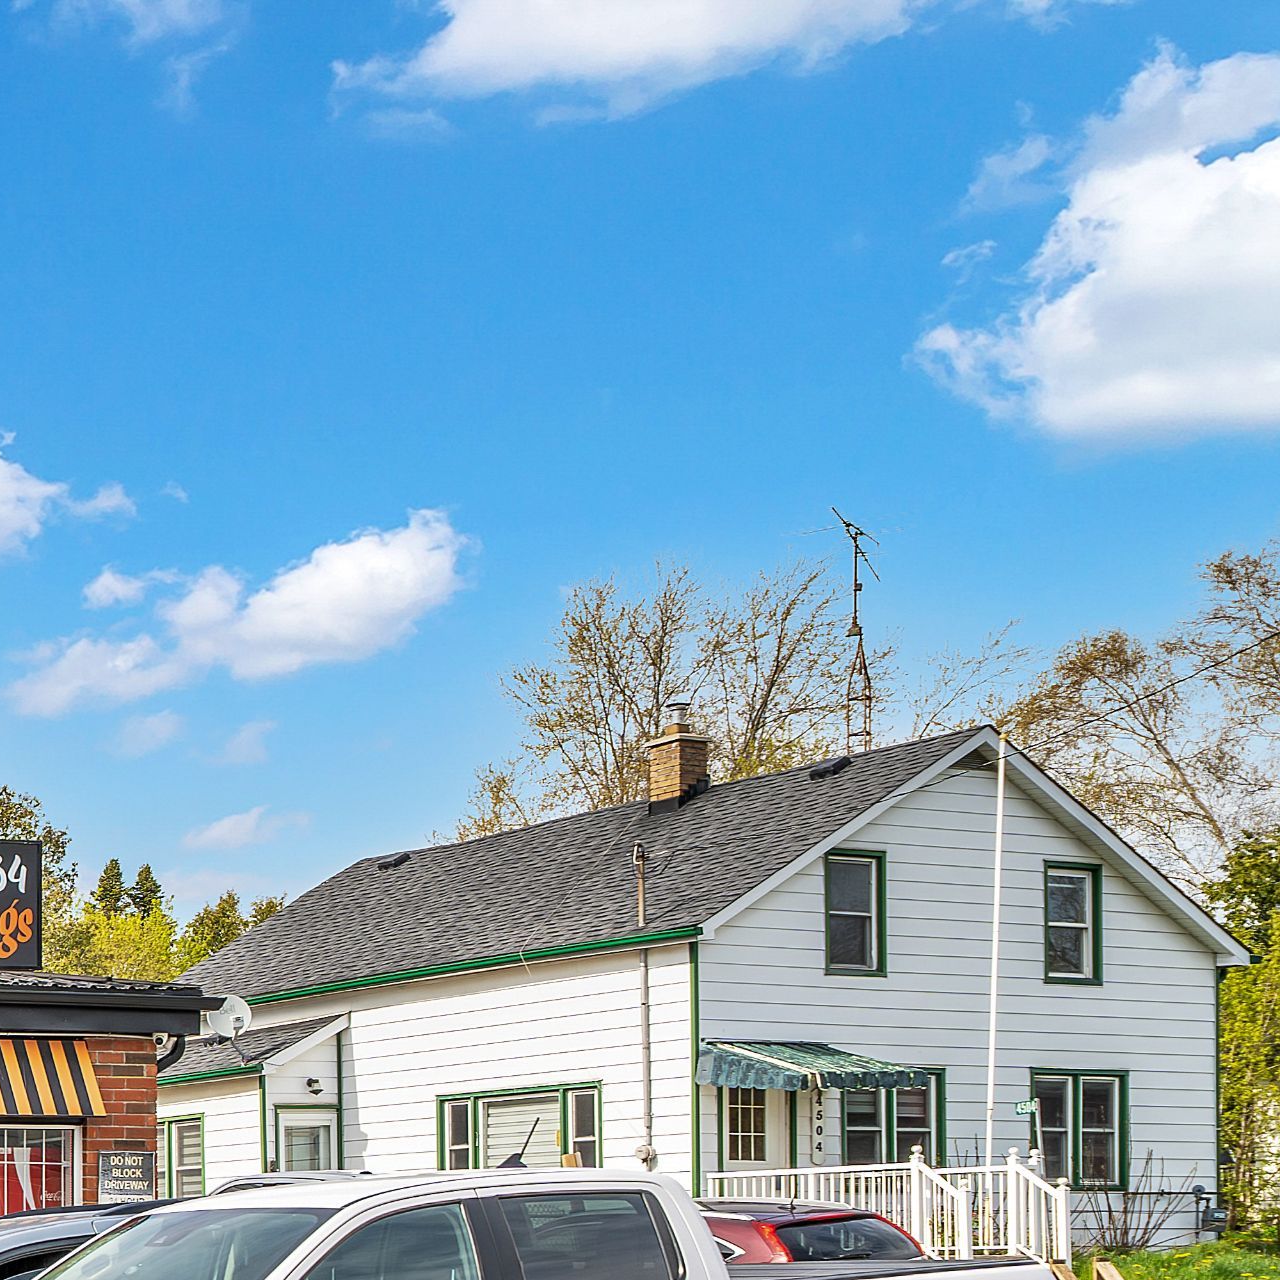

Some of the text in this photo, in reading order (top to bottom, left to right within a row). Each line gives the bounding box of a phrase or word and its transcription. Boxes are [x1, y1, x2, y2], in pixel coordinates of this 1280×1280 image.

[110, 1156, 143, 1166] DO NOT
[112, 1168, 143, 1178] BLOCK
[105, 1180, 149, 1190] DRIVEWAY
